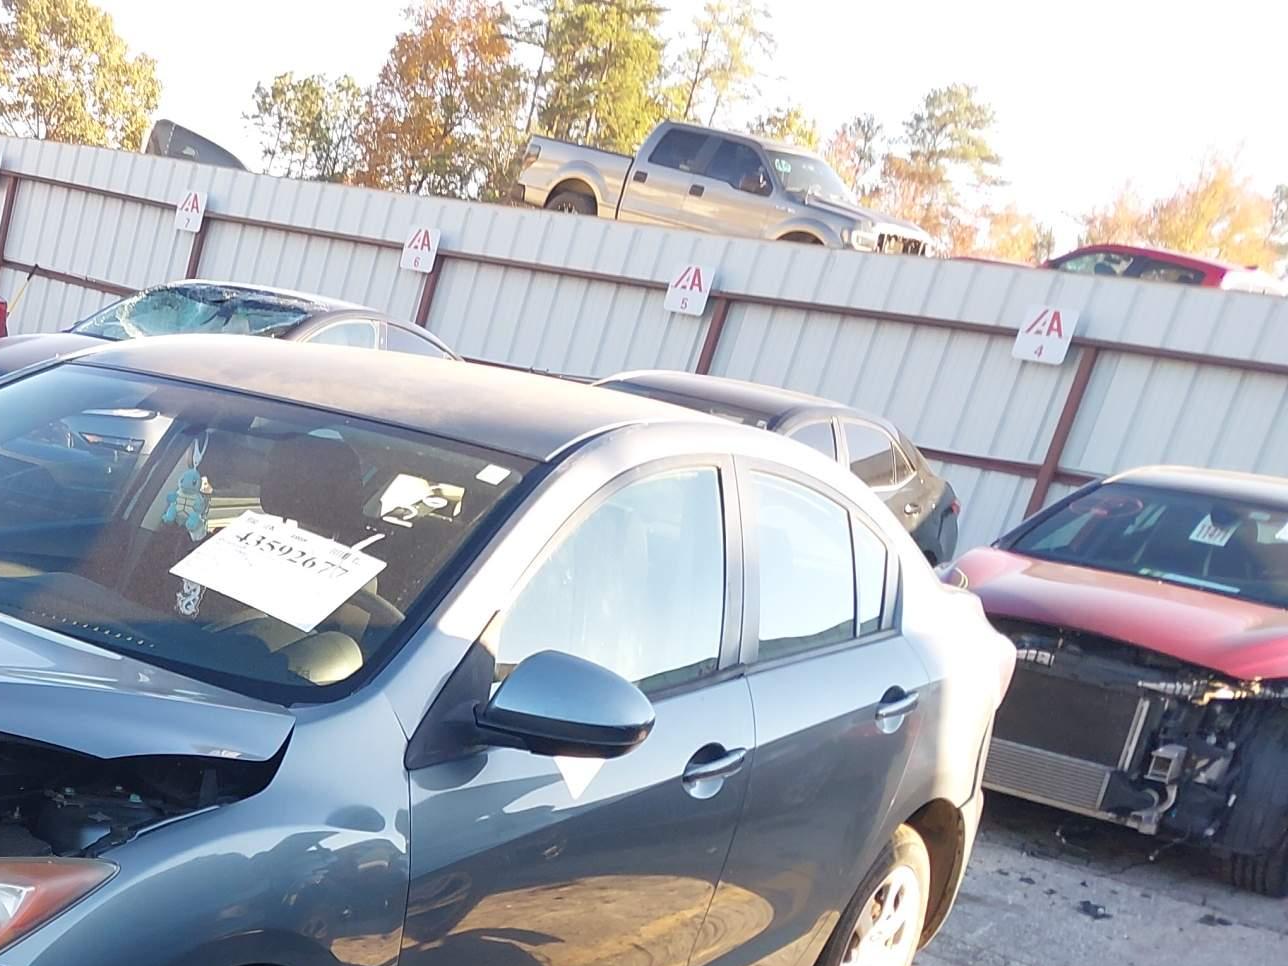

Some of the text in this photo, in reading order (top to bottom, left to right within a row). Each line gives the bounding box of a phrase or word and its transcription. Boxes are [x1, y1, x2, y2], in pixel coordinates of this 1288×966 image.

[184, 217, 191, 228] 7
[412, 256, 421, 268] 6
[679, 297, 689, 310] 5
[1033, 344, 1044, 358] 4
[235, 531, 349, 578] 43592677
